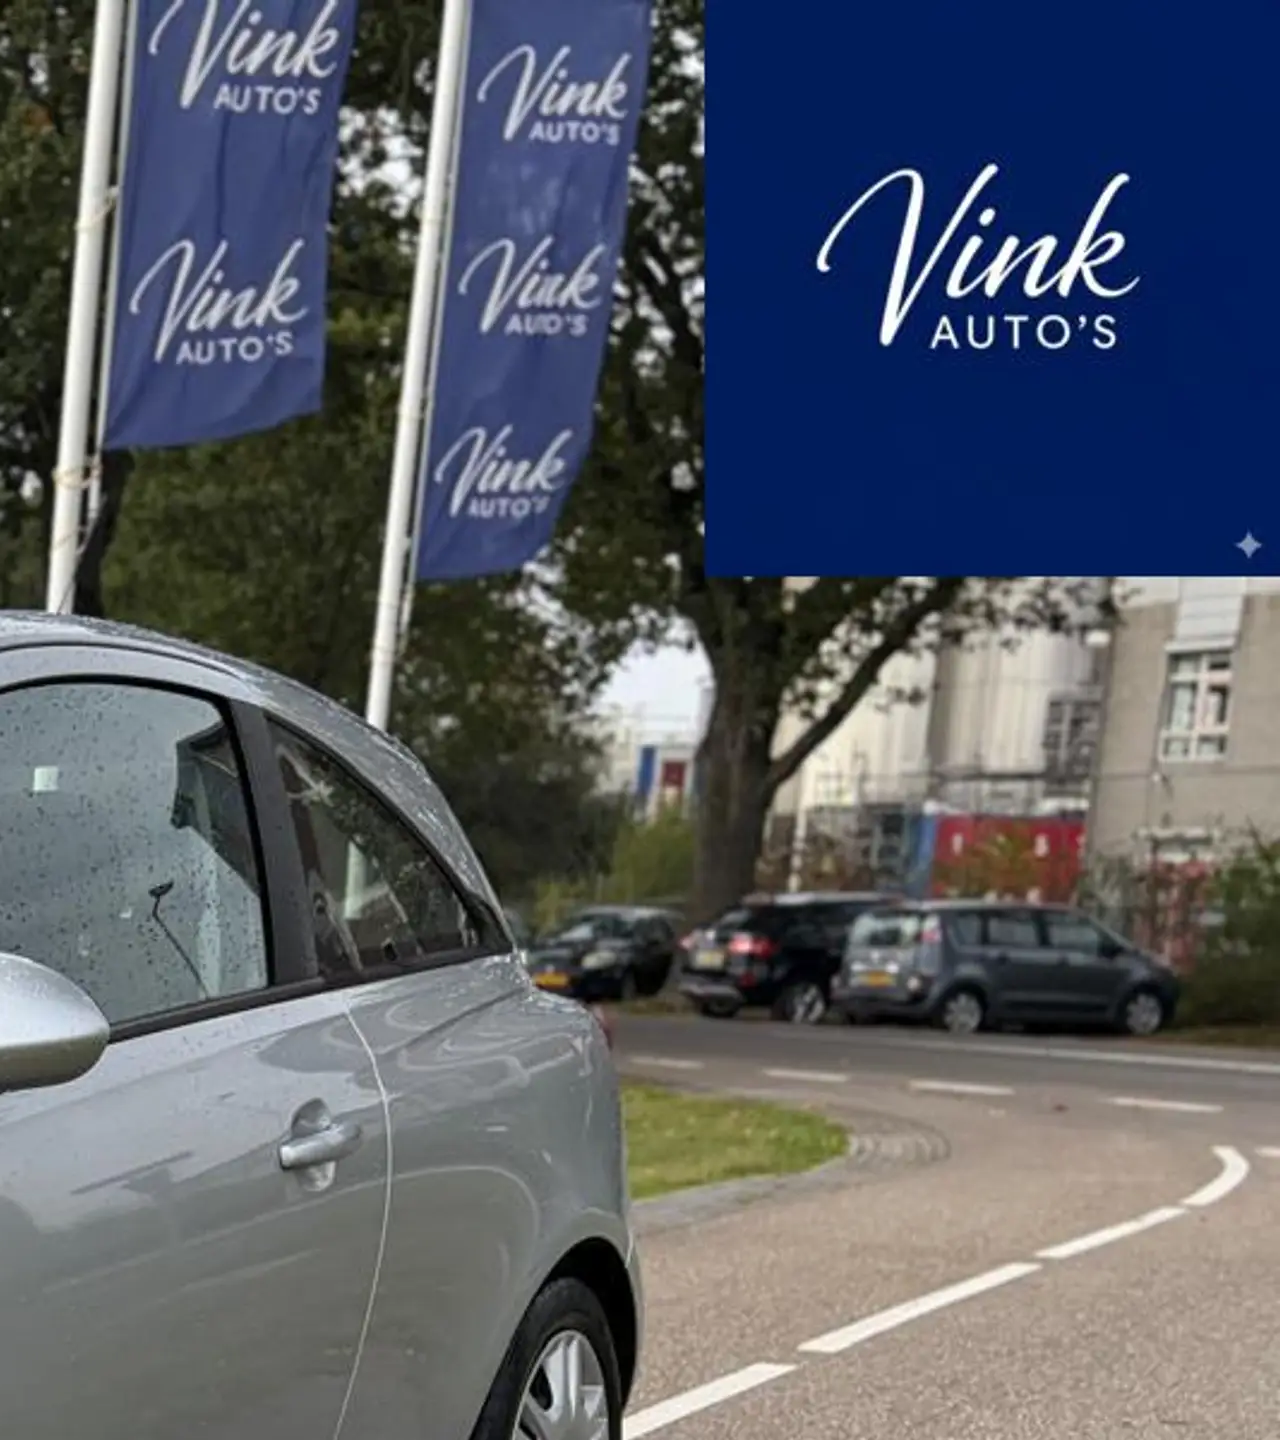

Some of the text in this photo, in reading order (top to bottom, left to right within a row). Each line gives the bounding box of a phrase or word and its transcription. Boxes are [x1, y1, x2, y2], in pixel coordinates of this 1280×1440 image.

[148, 0, 338, 108] Vink
[213, 83, 322, 115] AUTO'S
[477, 44, 632, 141] Vink
[129, 239, 309, 363] Vink
[175, 330, 293, 365] AUTO'S
[504, 312, 588, 337] AUO'S
[434, 423, 573, 517] Vink
